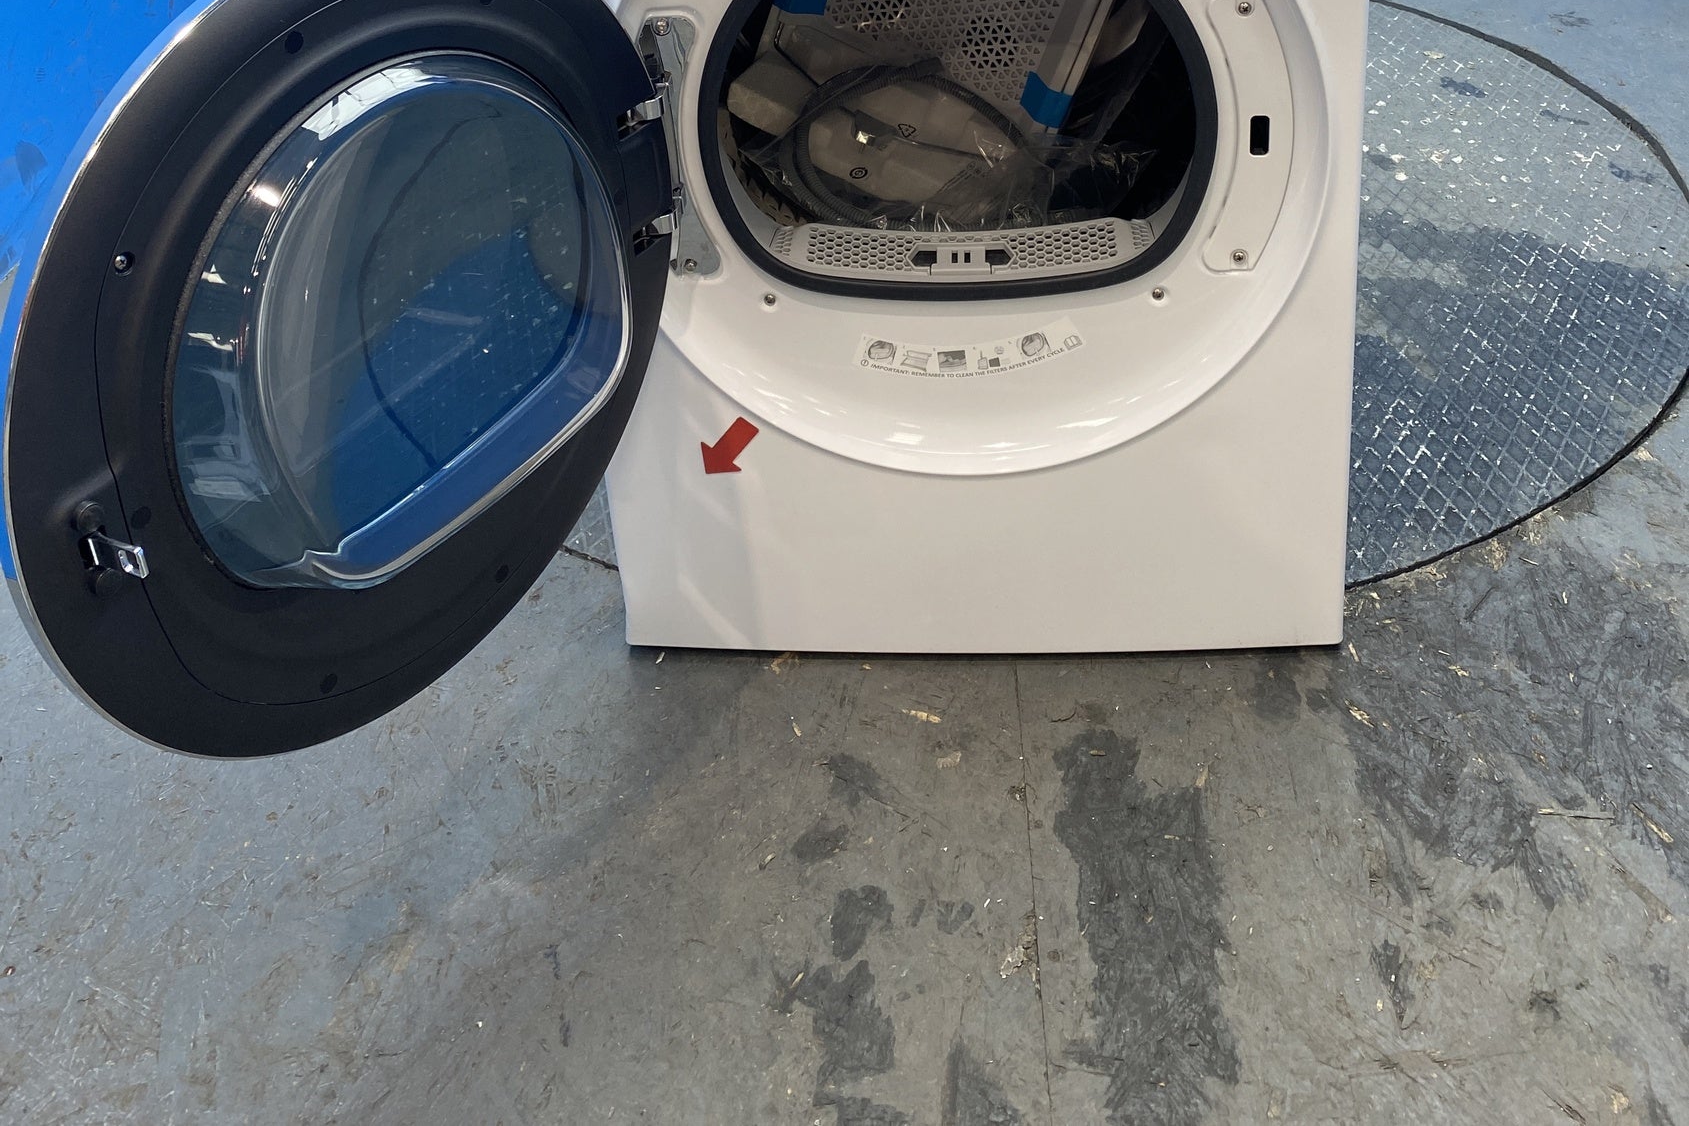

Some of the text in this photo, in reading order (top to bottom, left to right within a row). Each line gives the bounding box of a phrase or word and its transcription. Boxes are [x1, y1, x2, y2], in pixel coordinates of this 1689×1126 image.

[870, 363, 911, 376] IMPORTANT:
[986, 367, 1008, 375] FILTERS
[1008, 362, 1027, 371] AFTER
[1027, 355, 1046, 365] EVERY
[1046, 347, 1065, 358] CYCLE
